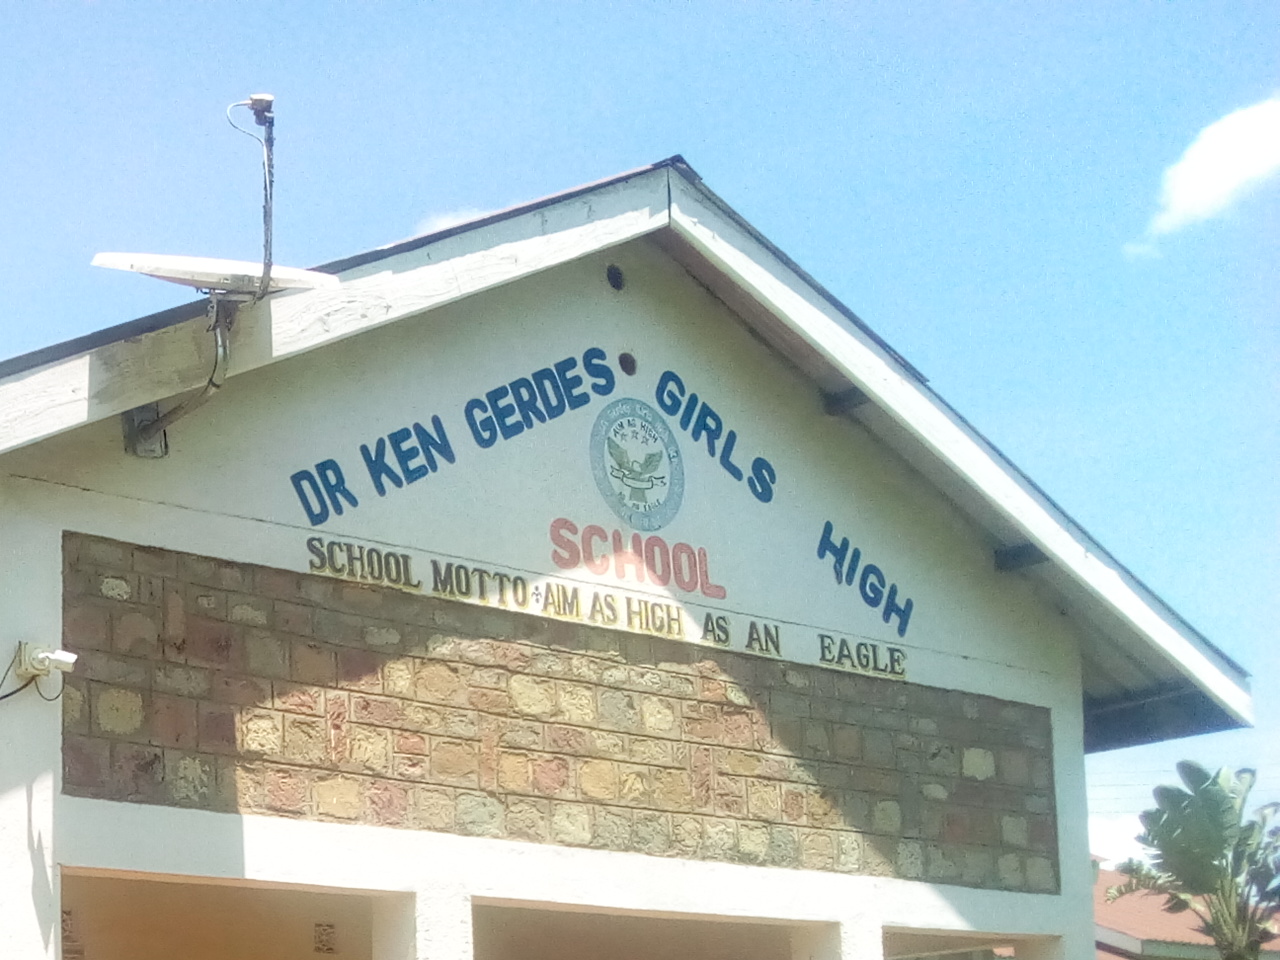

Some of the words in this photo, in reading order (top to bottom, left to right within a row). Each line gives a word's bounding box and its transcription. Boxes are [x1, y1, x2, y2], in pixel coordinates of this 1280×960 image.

[290, 459, 358, 526] DR
[360, 414, 456, 497] KEN
[465, 347, 615, 449] GERDES
[655, 370, 777, 504] GIRLS
[817, 521, 913, 637] HIGH
[549, 517, 727, 600] SCHOOL
[306, 536, 421, 588] SCHOOL
[541, 581, 581, 618] AIM
[588, 591, 618, 626] AS
[625, 595, 685, 639] HIGH
[701, 611, 730, 644] AS
[745, 619, 781, 656] AN
[818, 632, 907, 677] EAGLE
